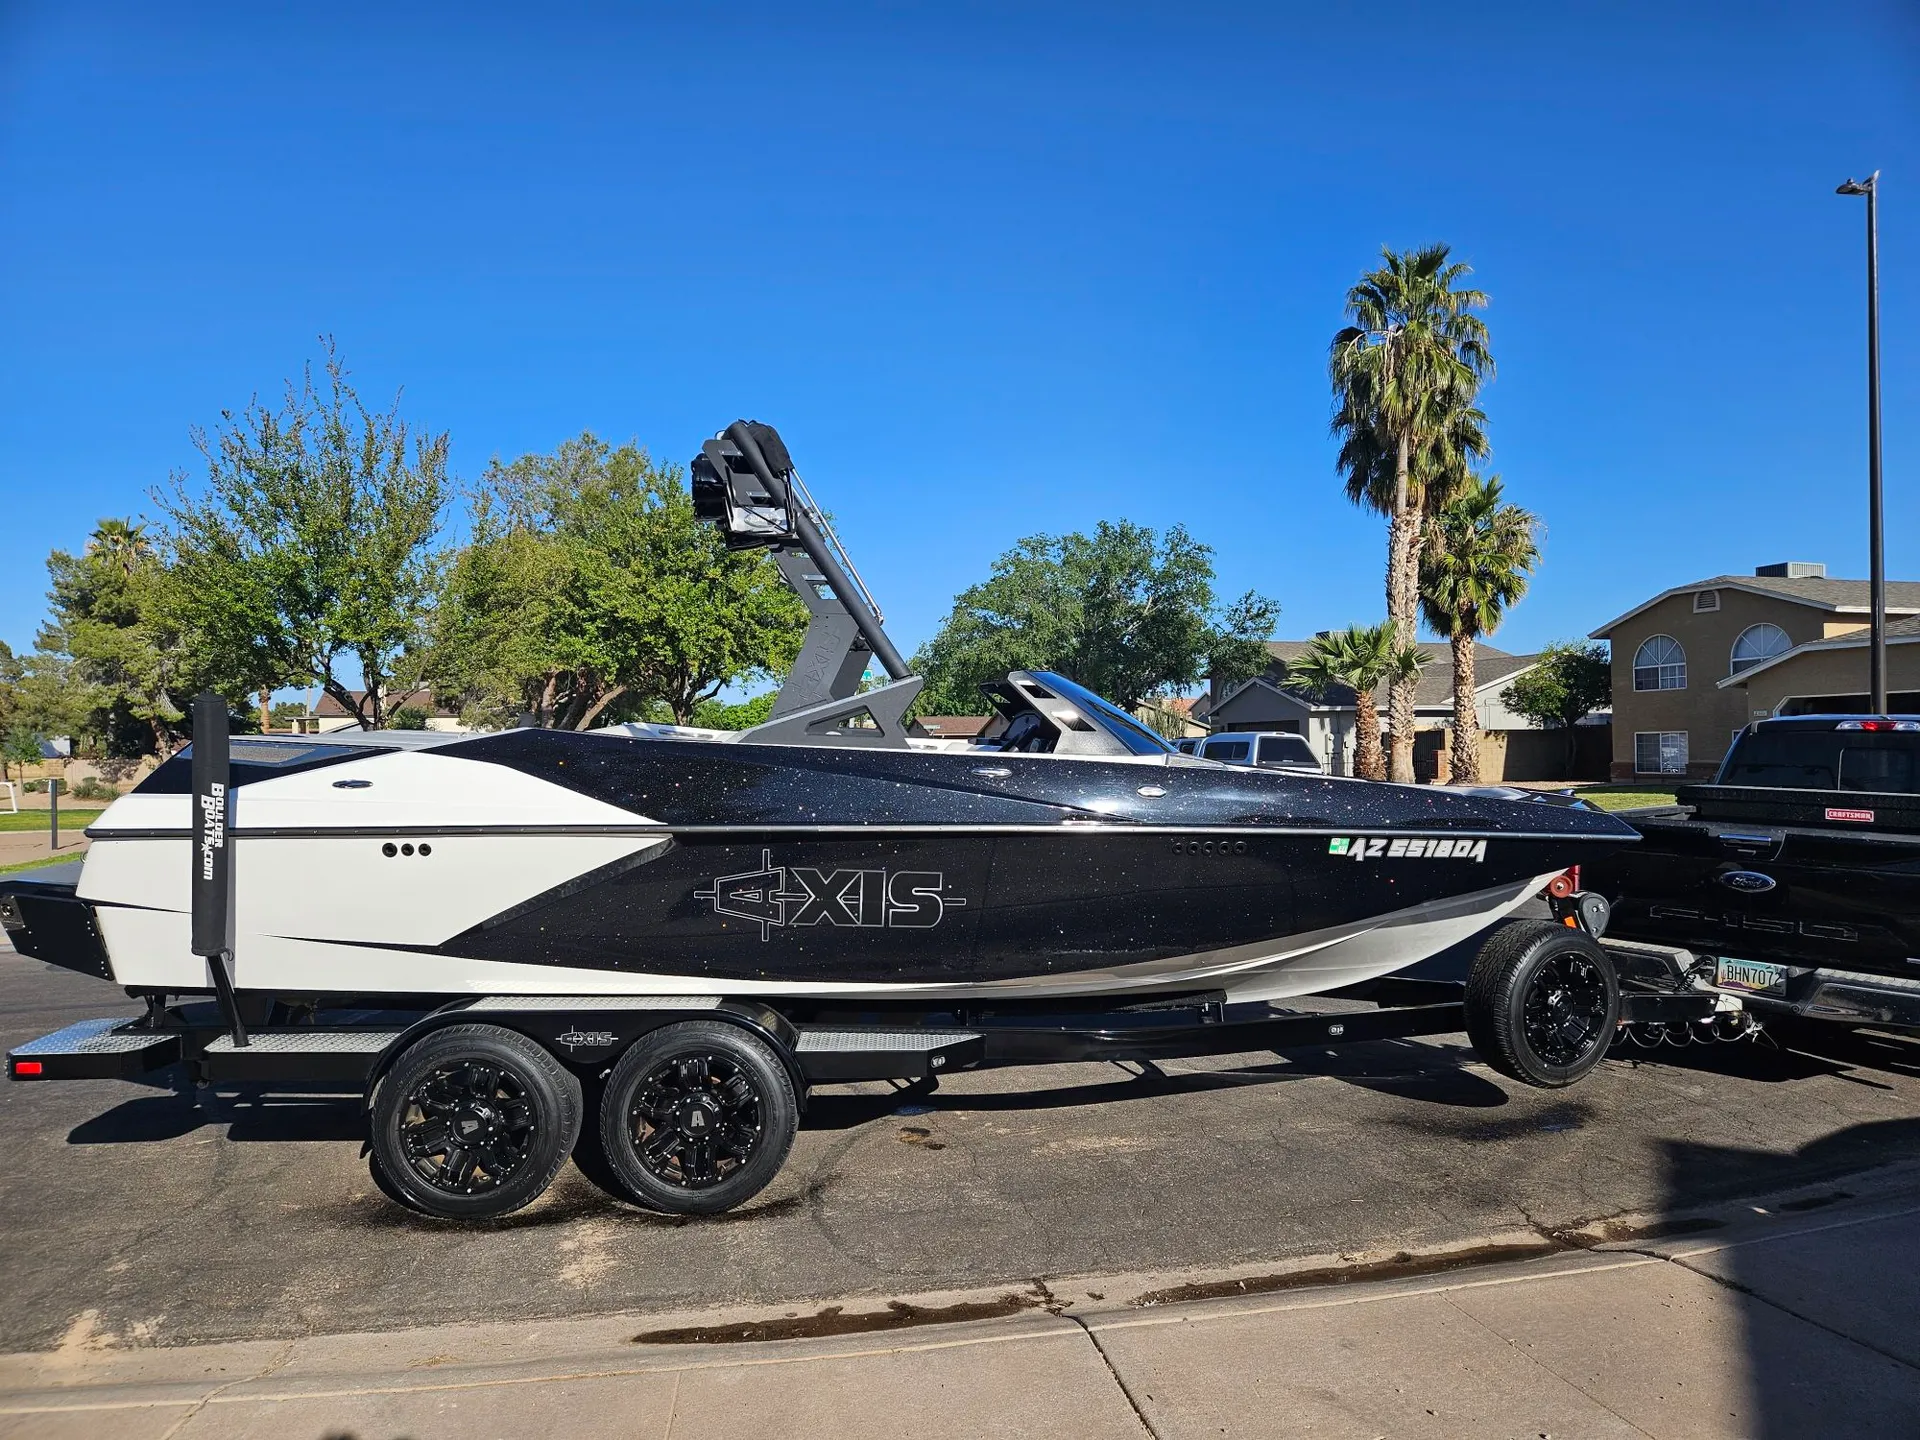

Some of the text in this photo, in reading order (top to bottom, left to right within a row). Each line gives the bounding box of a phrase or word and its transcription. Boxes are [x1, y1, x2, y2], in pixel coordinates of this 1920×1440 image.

[211, 782, 225, 848] BOULDER
[1828, 811, 1871, 820] CRAFTSMAN
[1346, 838, 1388, 862] AZ
[1726, 965, 1782, 987] BHN7072
